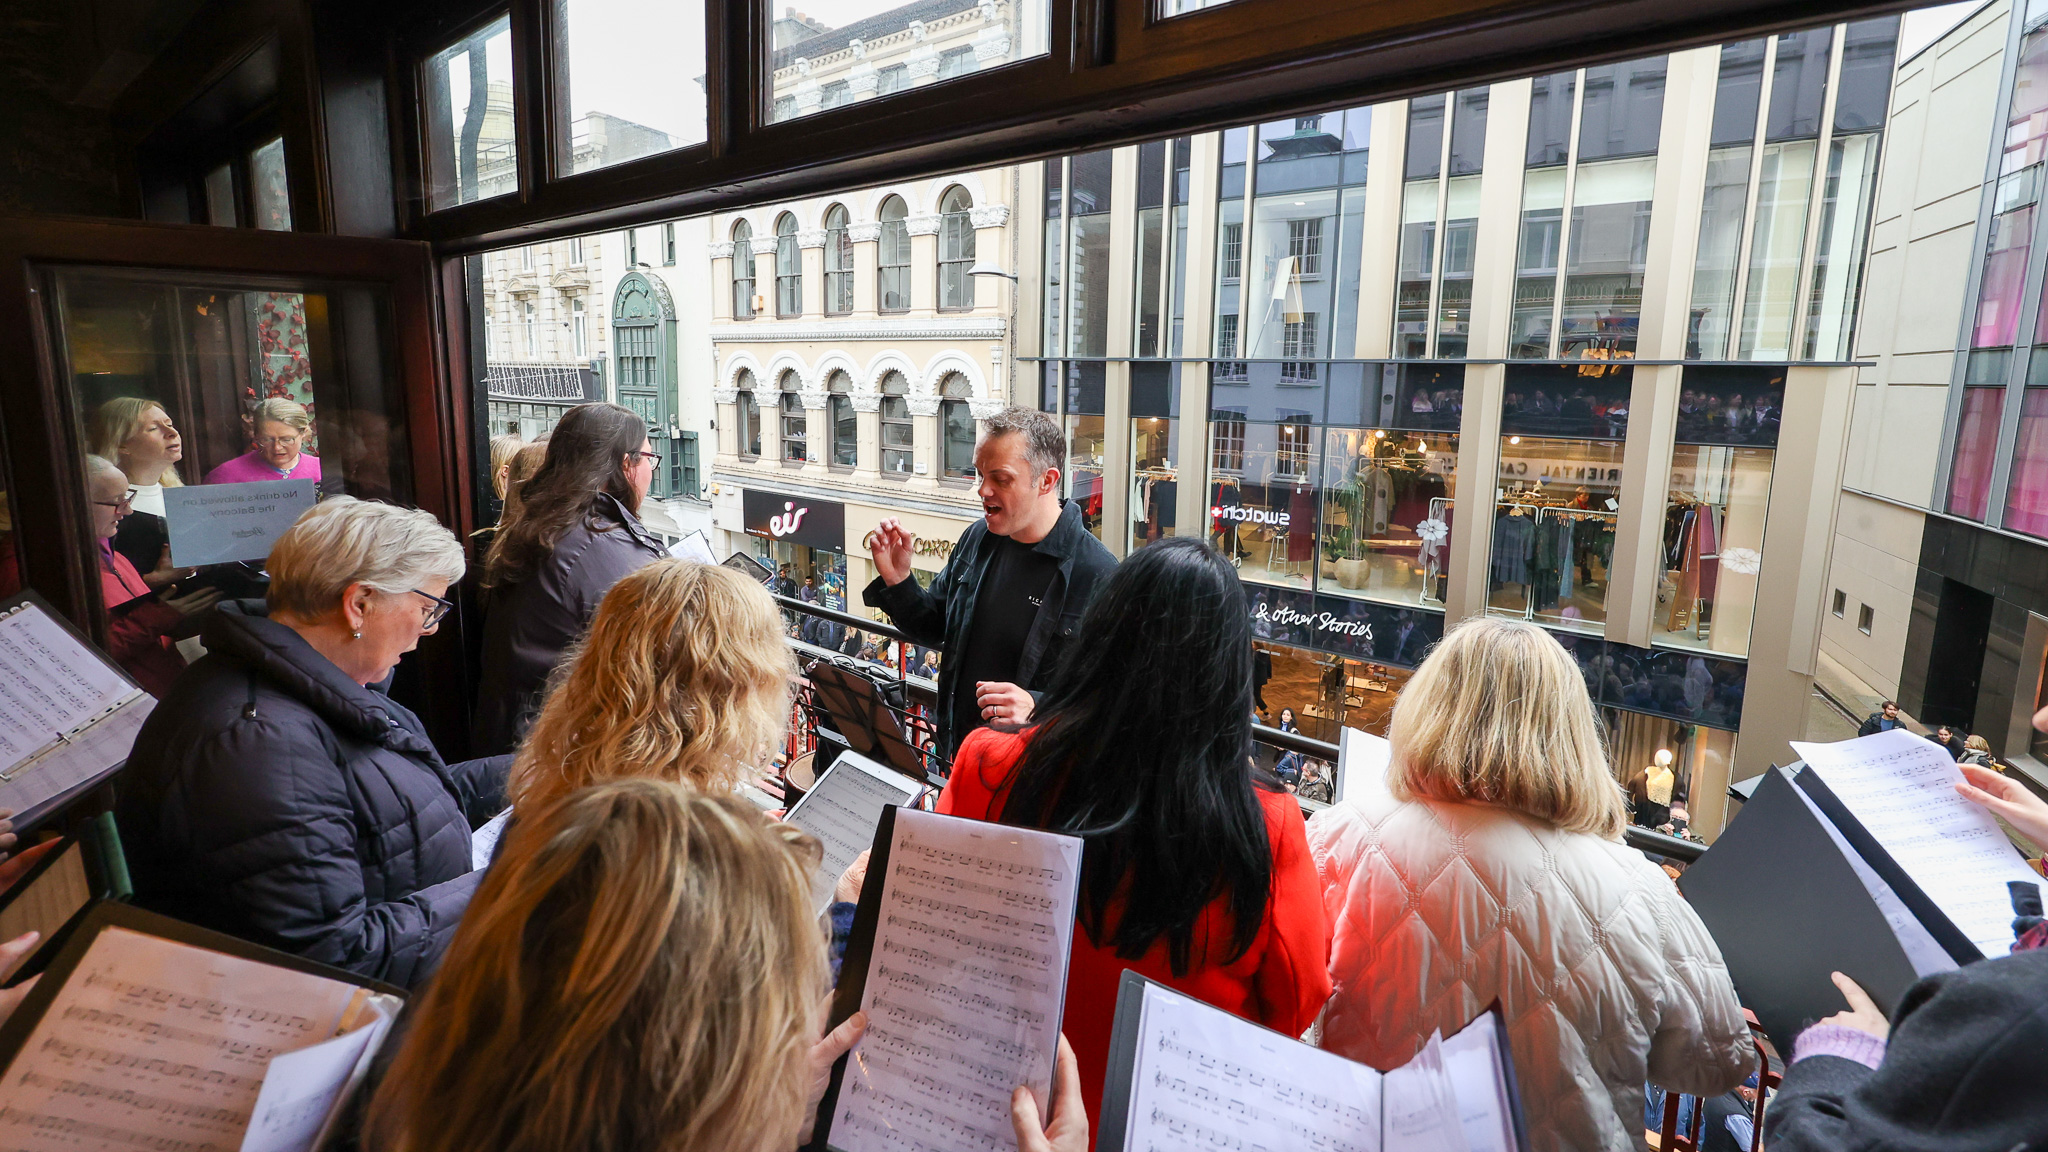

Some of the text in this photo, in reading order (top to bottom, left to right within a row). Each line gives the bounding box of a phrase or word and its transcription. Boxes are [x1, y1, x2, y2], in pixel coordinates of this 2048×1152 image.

[769, 501, 808, 537] eir
[1256, 602, 1373, 640] & other Stories
